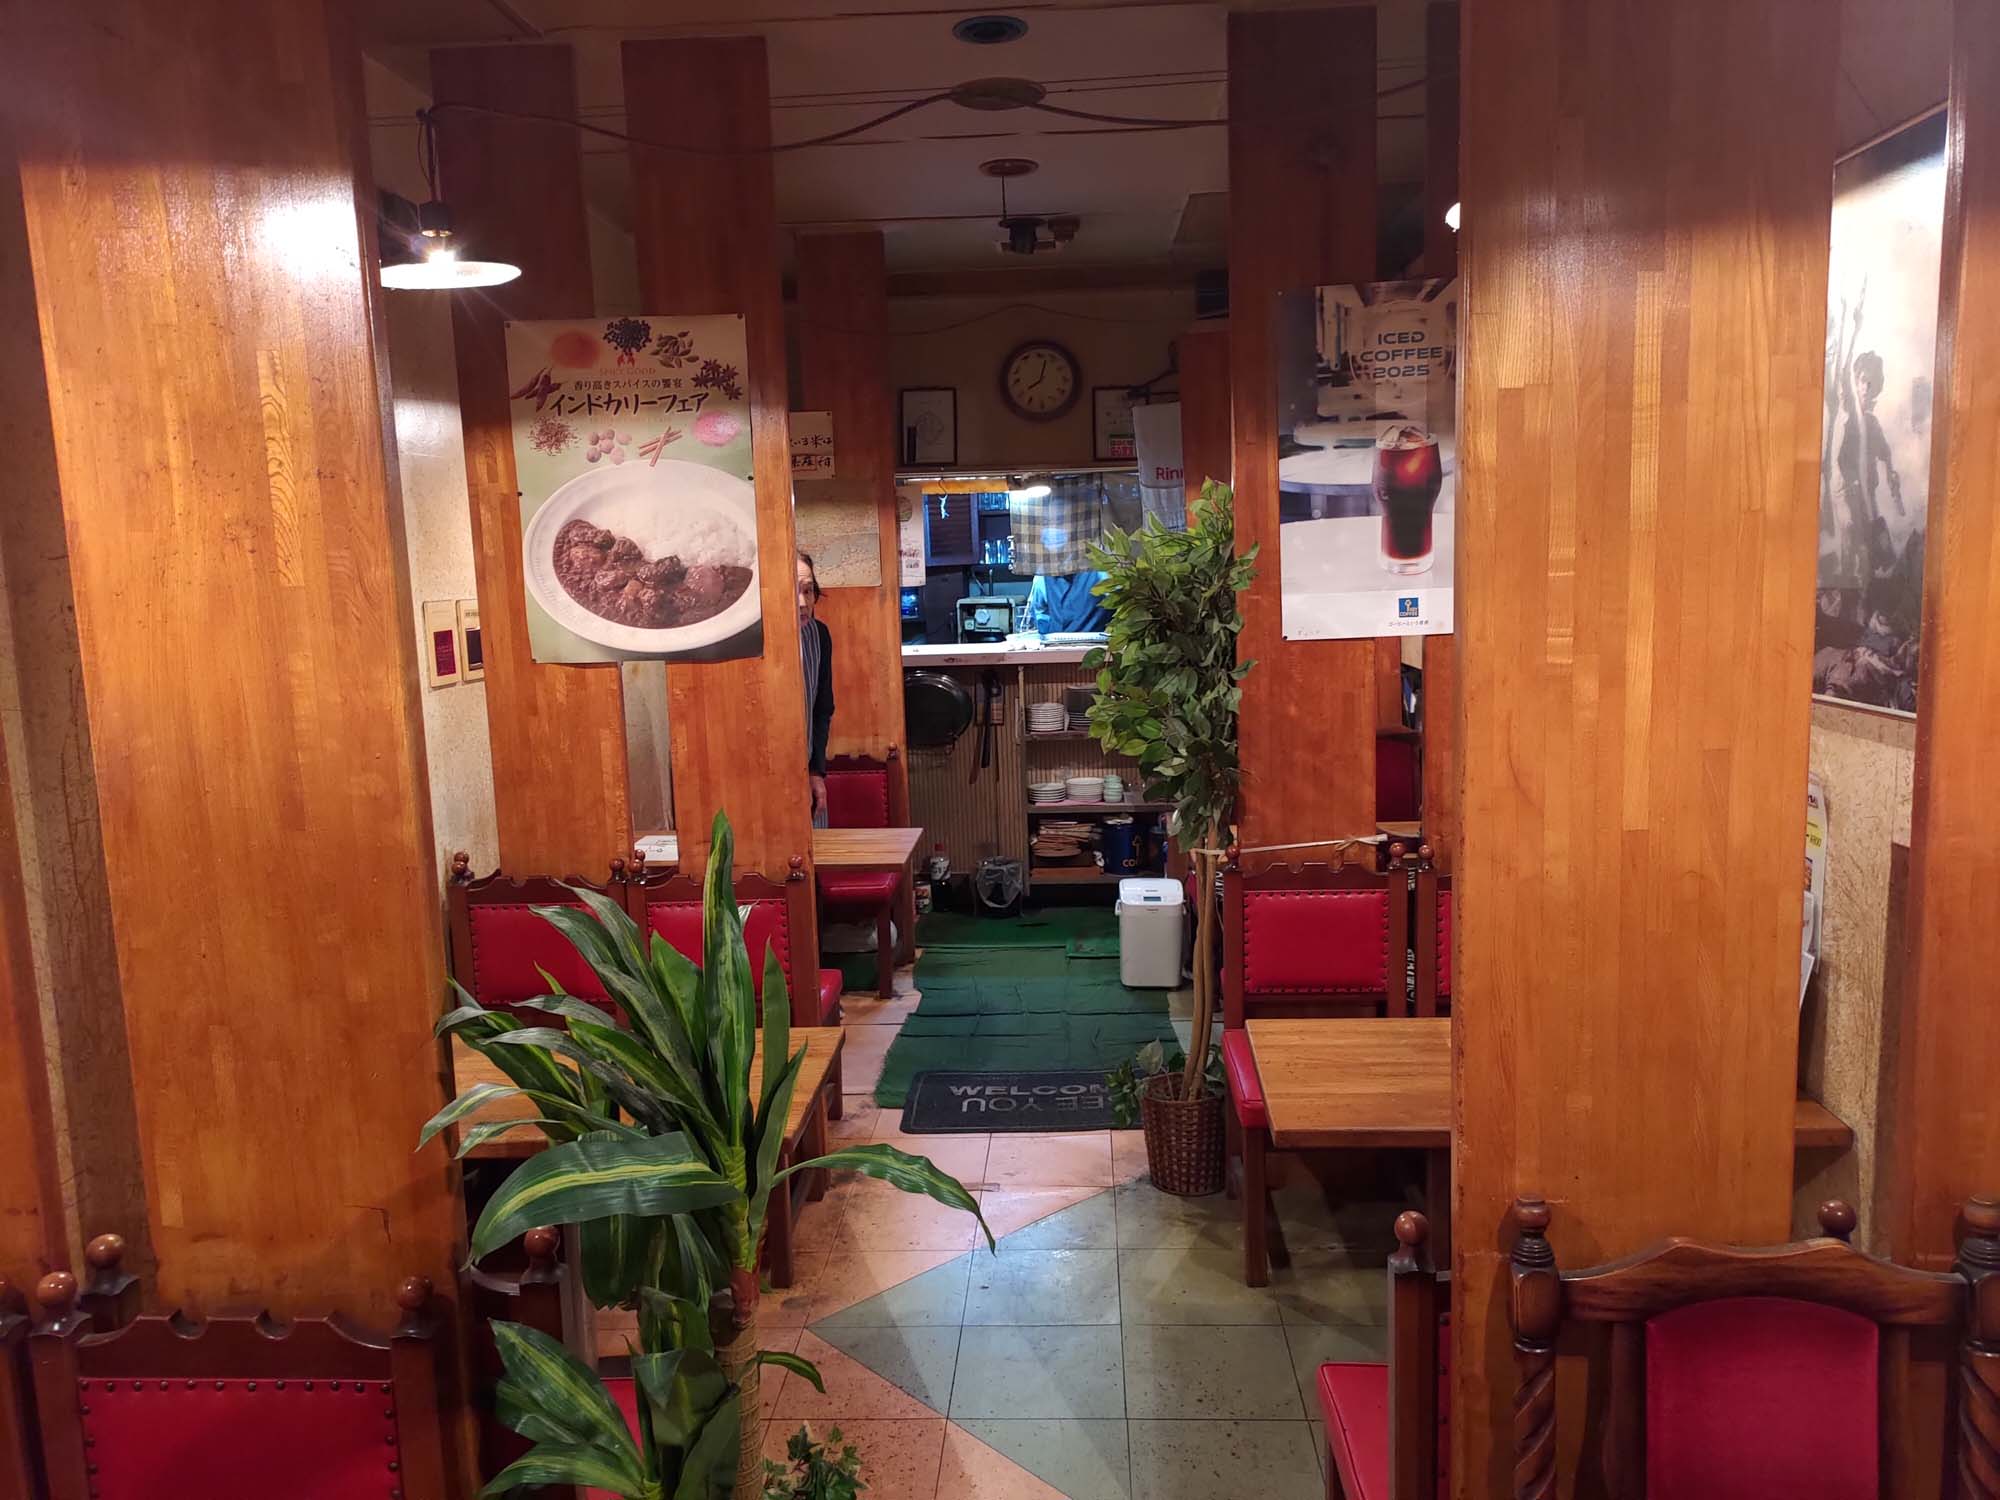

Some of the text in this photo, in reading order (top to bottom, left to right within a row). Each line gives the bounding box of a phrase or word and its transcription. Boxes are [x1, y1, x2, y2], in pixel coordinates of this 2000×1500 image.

[1377, 331, 1425, 345] ICED
[1360, 347, 1443, 363] COFFEE
[1373, 365, 1430, 379] 2025
[550, 392, 709, 416] インドカリーフェア
[949, 1084, 1110, 1096] WELCOM
[962, 1097, 1044, 1113] YOU
